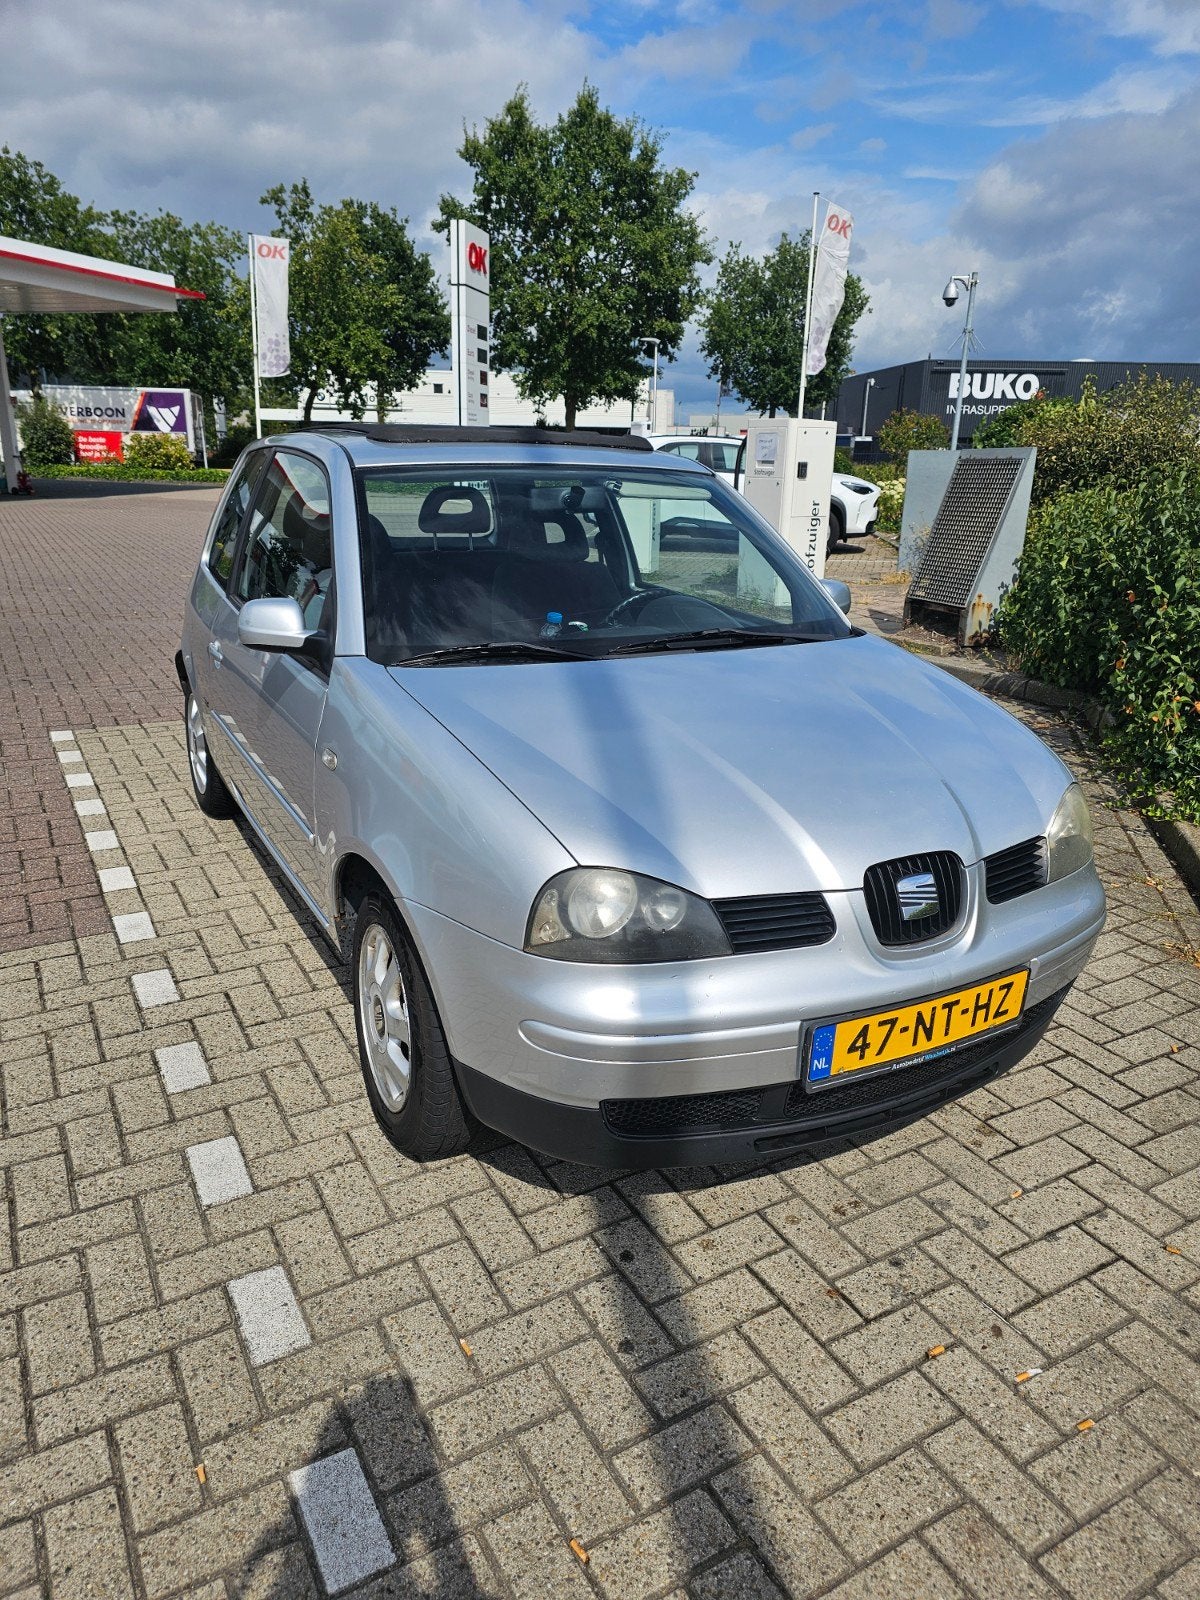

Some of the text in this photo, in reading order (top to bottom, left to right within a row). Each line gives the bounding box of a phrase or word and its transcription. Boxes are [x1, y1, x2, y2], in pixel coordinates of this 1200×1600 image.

[828, 214, 851, 239] OK
[257, 243, 286, 260] OK
[468, 242, 487, 275] OK
[948, 373, 1039, 400] BUKO
[59, 406, 126, 418] VERBOON
[805, 500, 821, 573] ofzuiger
[847, 982, 1014, 1061] 47-NT-HZ
[813, 1057, 829, 1070] NL
